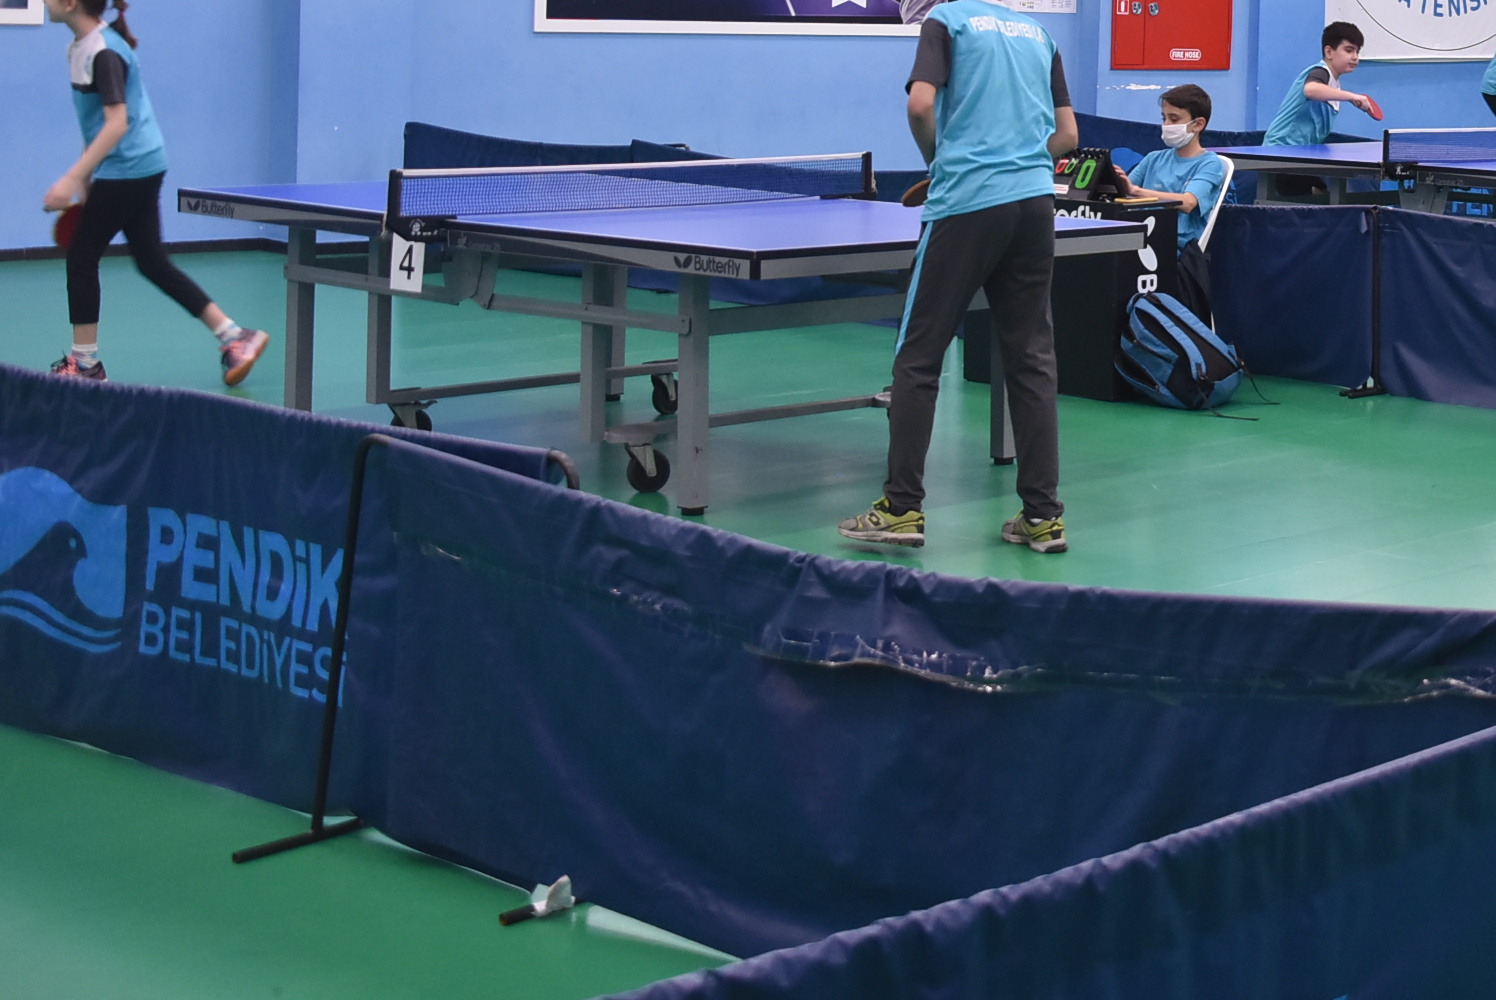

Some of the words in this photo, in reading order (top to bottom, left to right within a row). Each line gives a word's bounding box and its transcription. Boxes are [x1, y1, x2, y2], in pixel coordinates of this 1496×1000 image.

[1075, 159, 1096, 189] 0
[201, 200, 235, 218] Butterfly
[399, 244, 415, 280] 4
[694, 255, 741, 277] Butterfly
[145, 507, 349, 638] PENDİK
